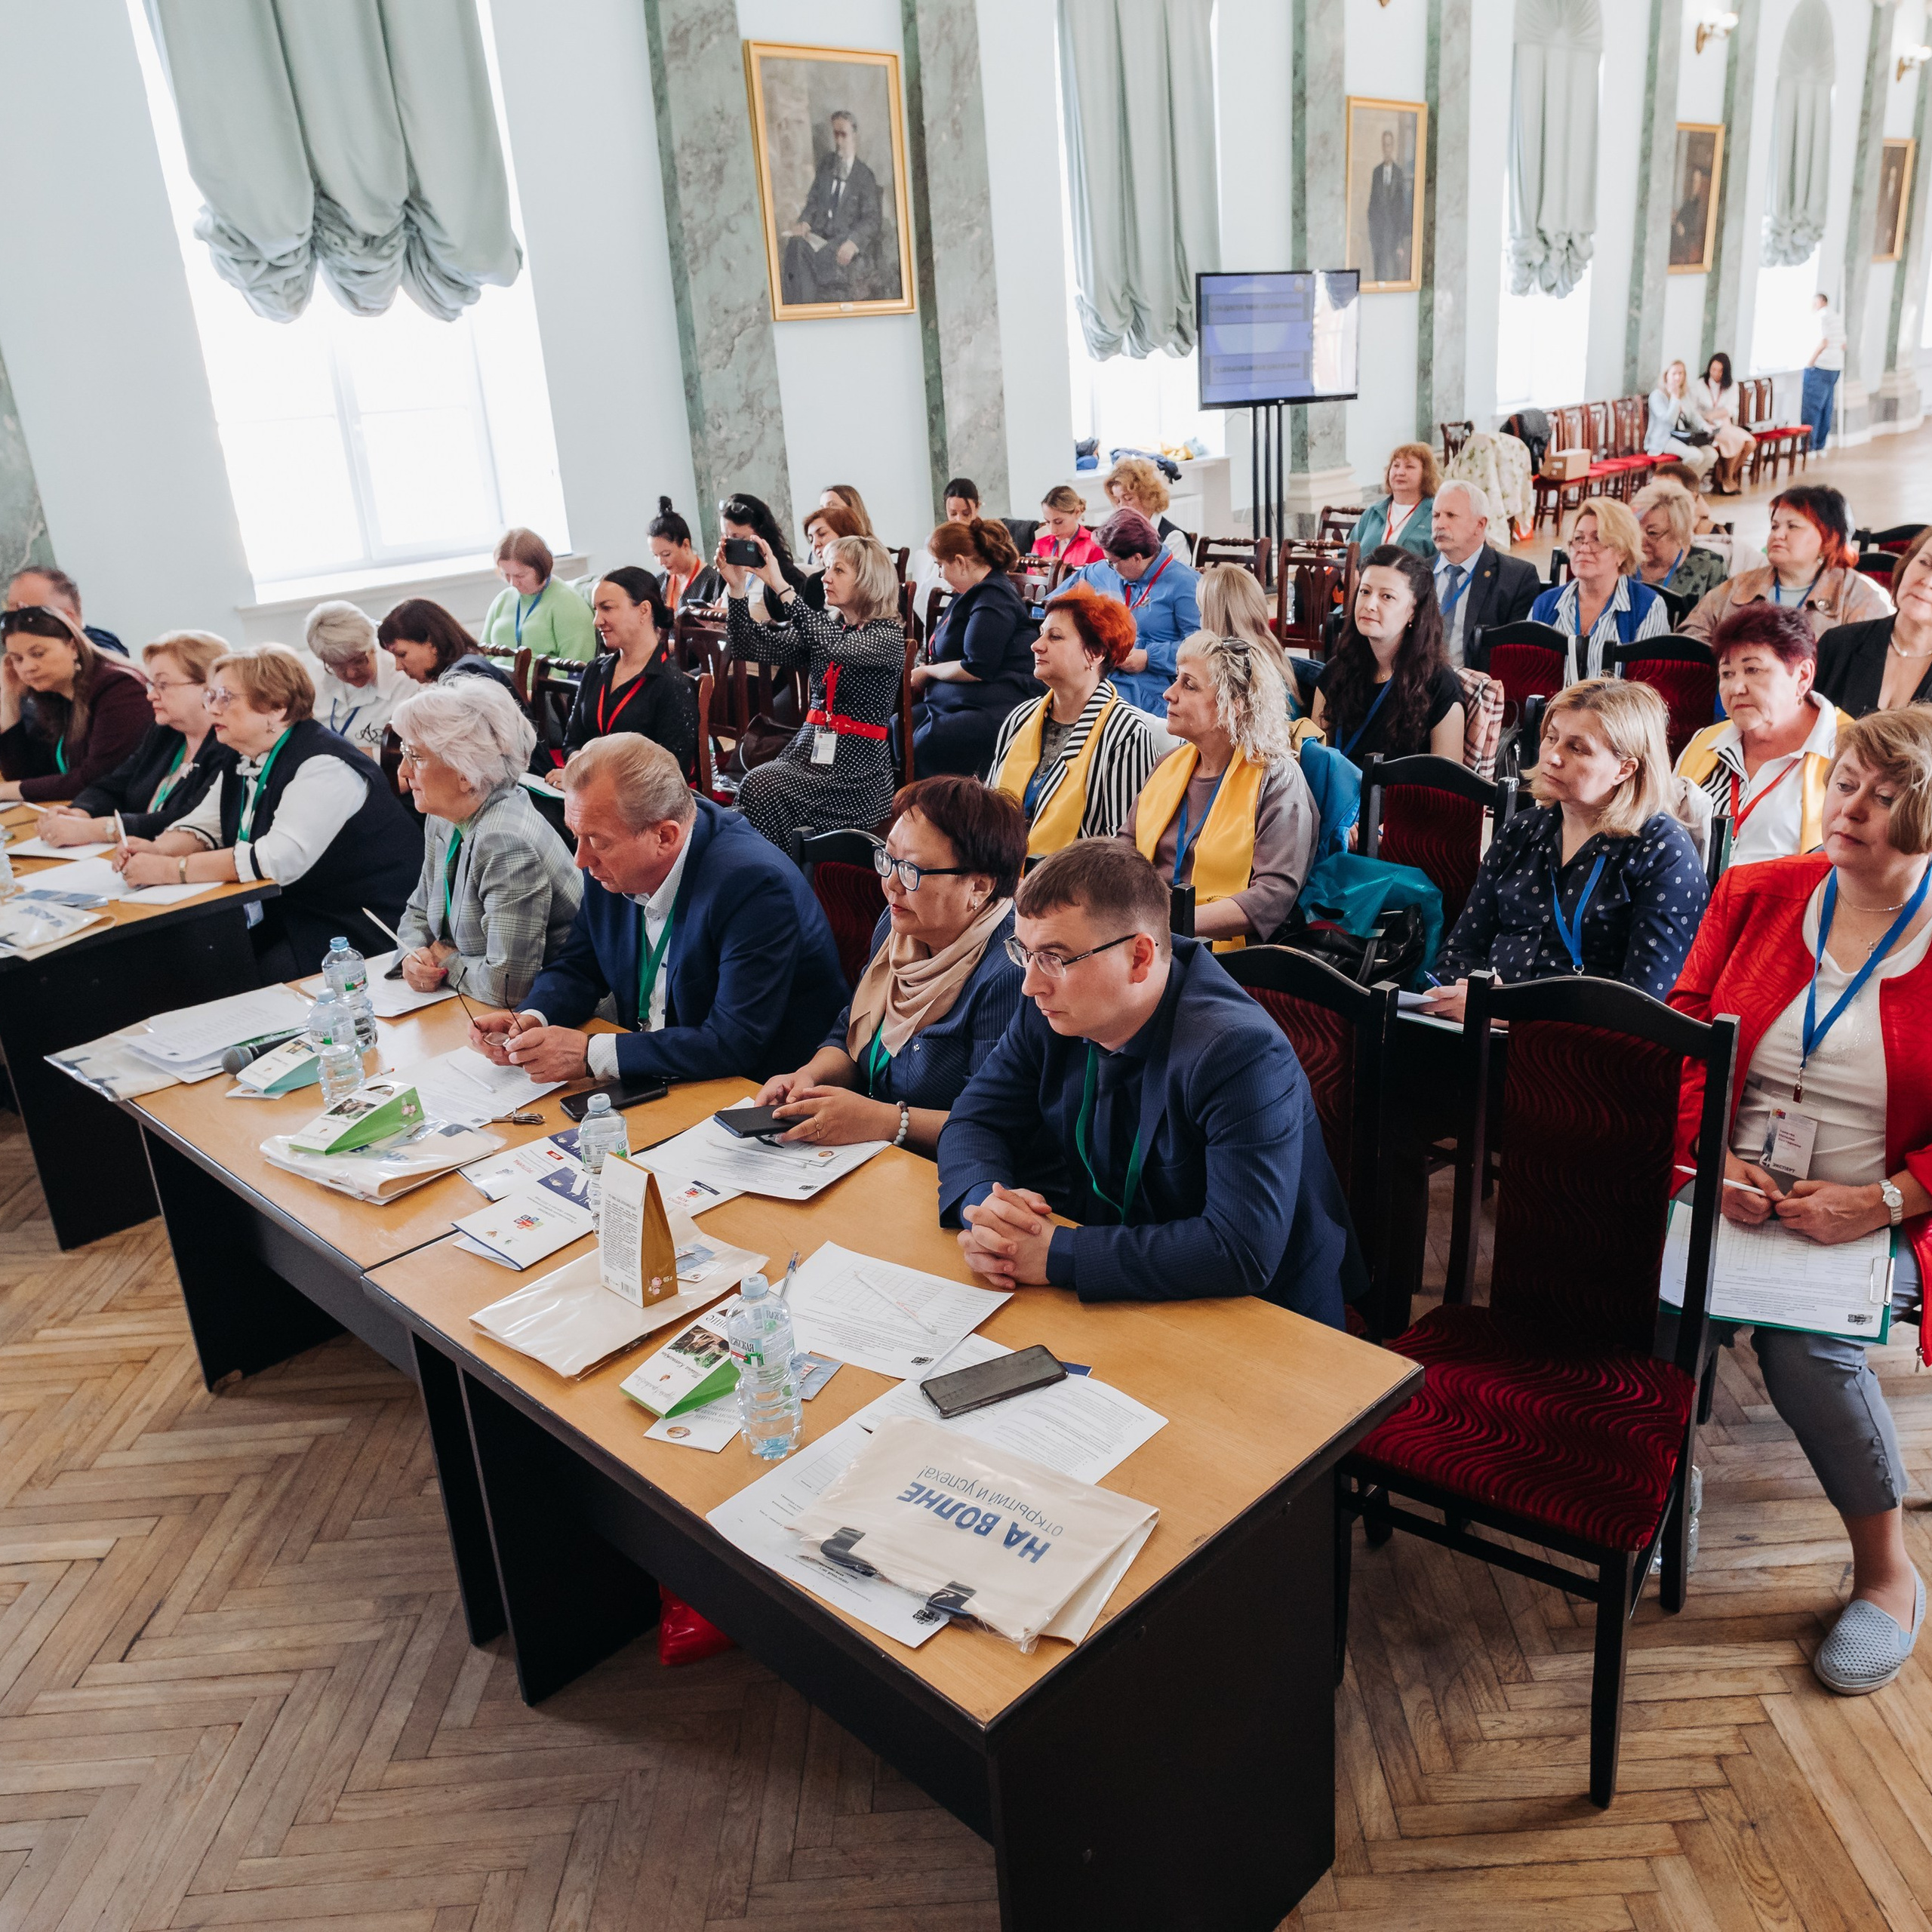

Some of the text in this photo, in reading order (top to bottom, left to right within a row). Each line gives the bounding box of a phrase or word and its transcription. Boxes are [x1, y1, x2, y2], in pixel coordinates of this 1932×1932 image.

[895, 1481, 1052, 1564] НА ВОЛНЕ
[916, 1465, 1064, 1537] открытий и успеха!
